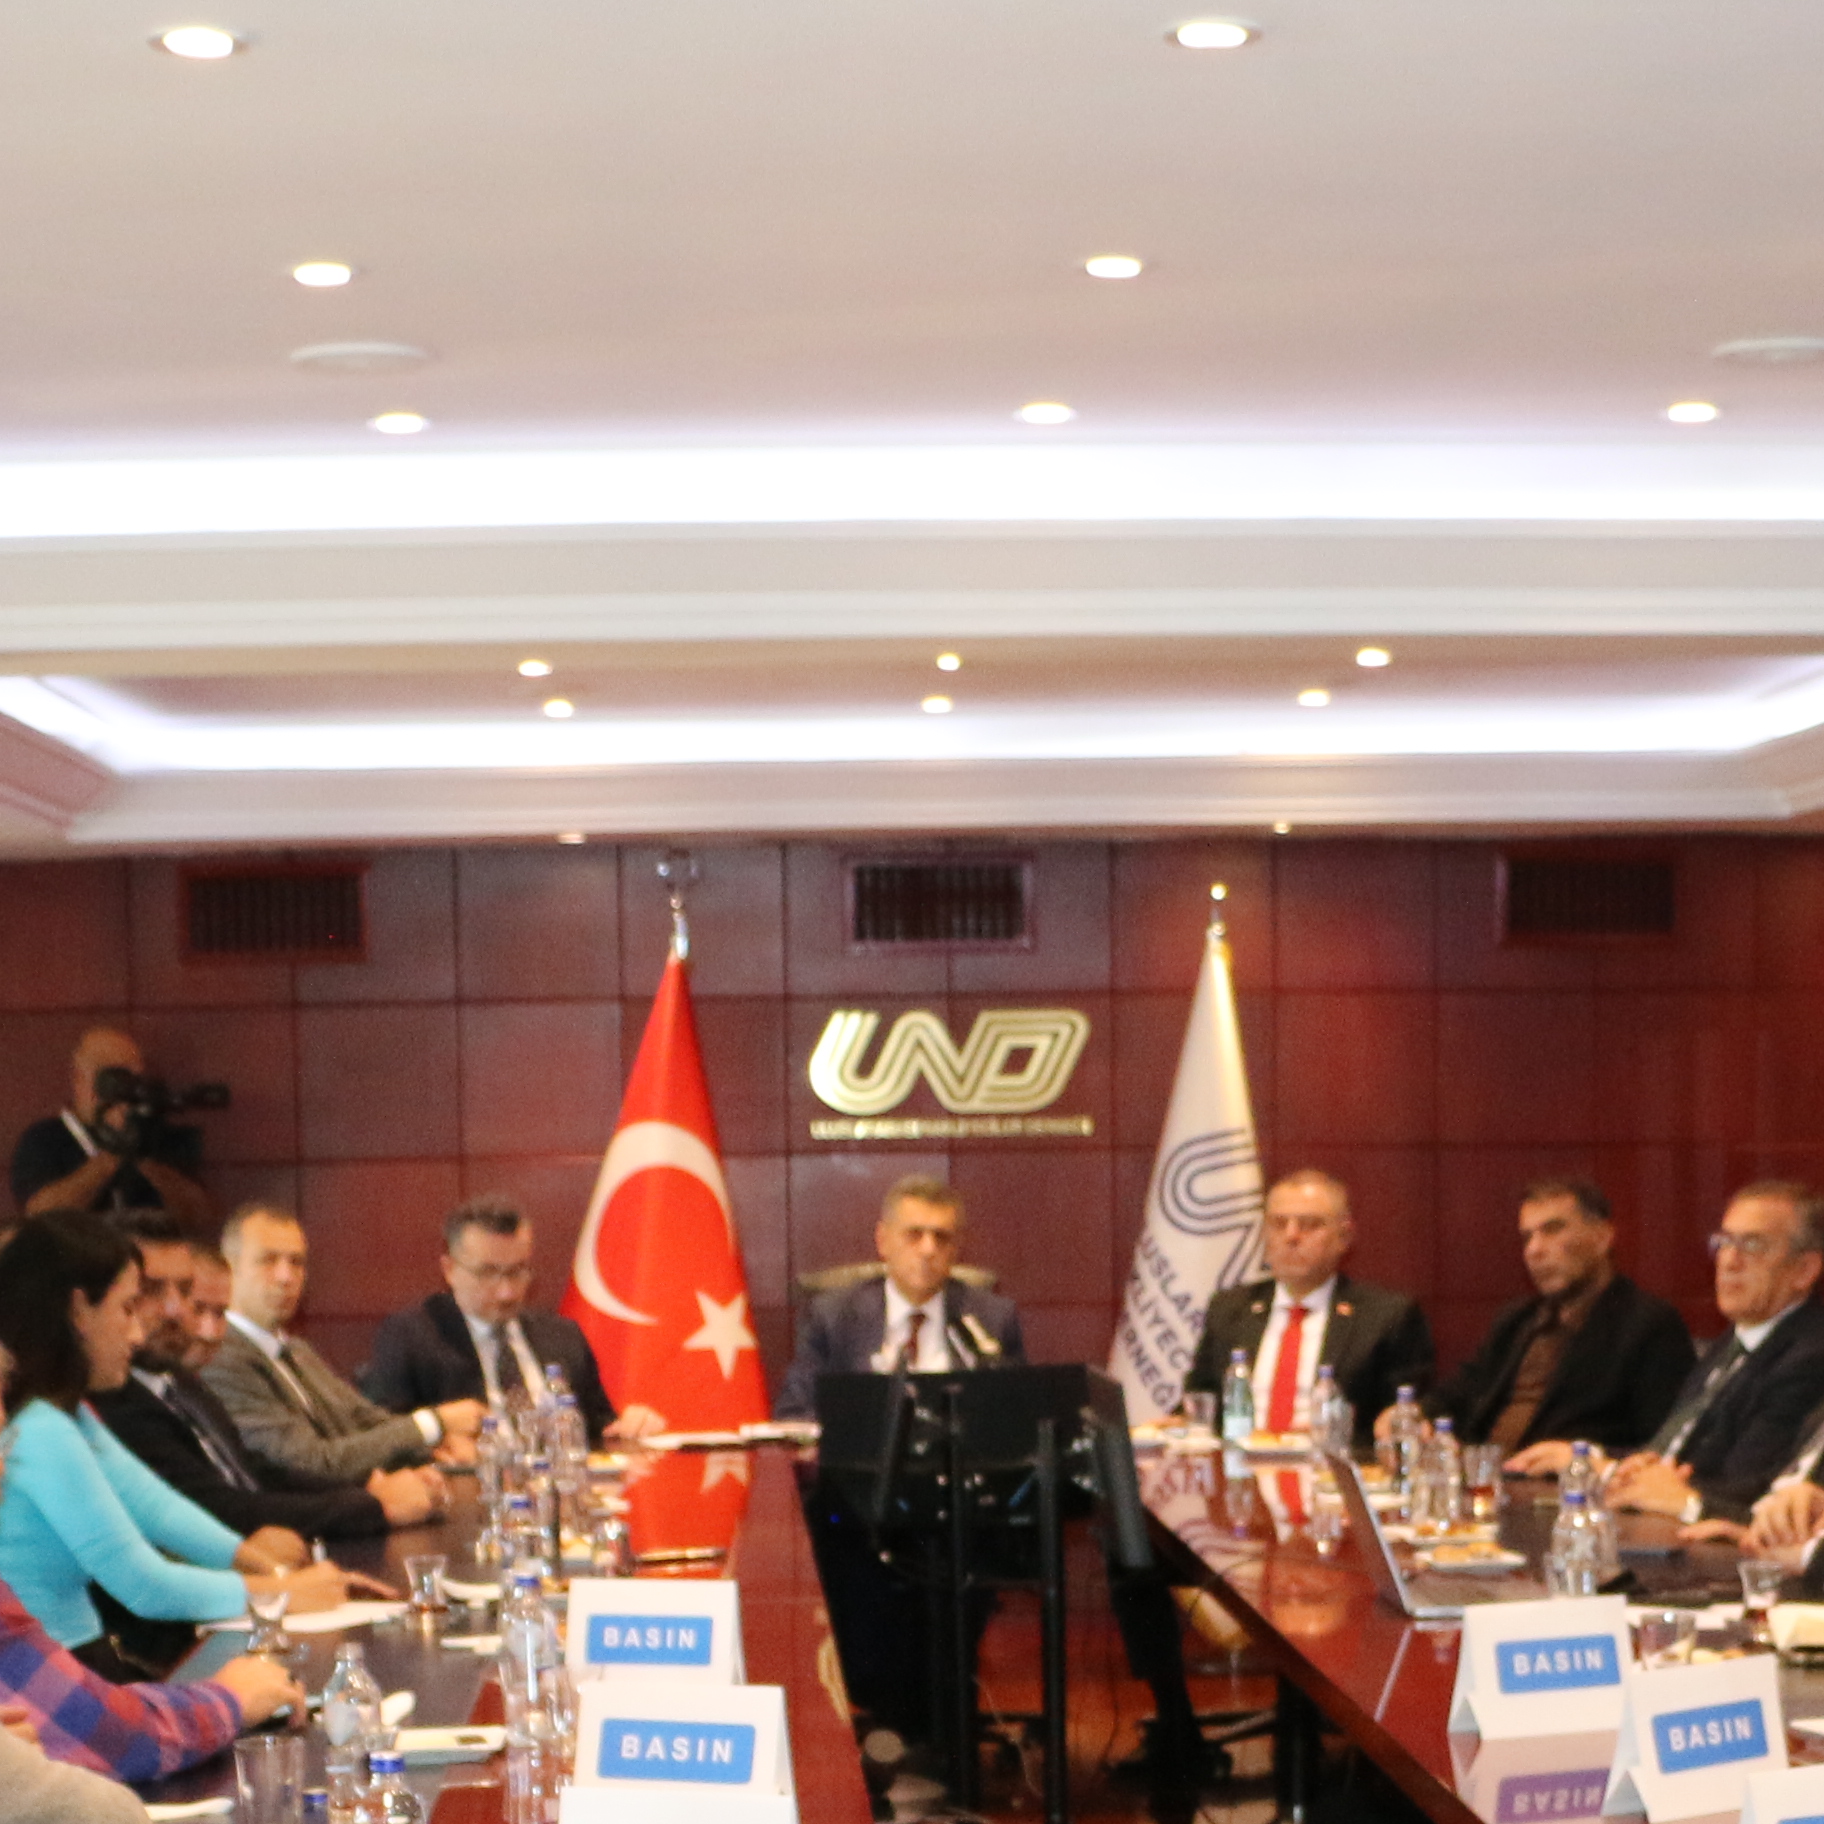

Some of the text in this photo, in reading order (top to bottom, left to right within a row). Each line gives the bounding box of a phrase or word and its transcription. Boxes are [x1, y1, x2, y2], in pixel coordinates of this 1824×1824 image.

[602, 1626, 698, 1651] BASIN
[1512, 1649, 1604, 1676] BASIN
[618, 1732, 734, 1765] BASIN
[1668, 1716, 1752, 1752] BASIN
